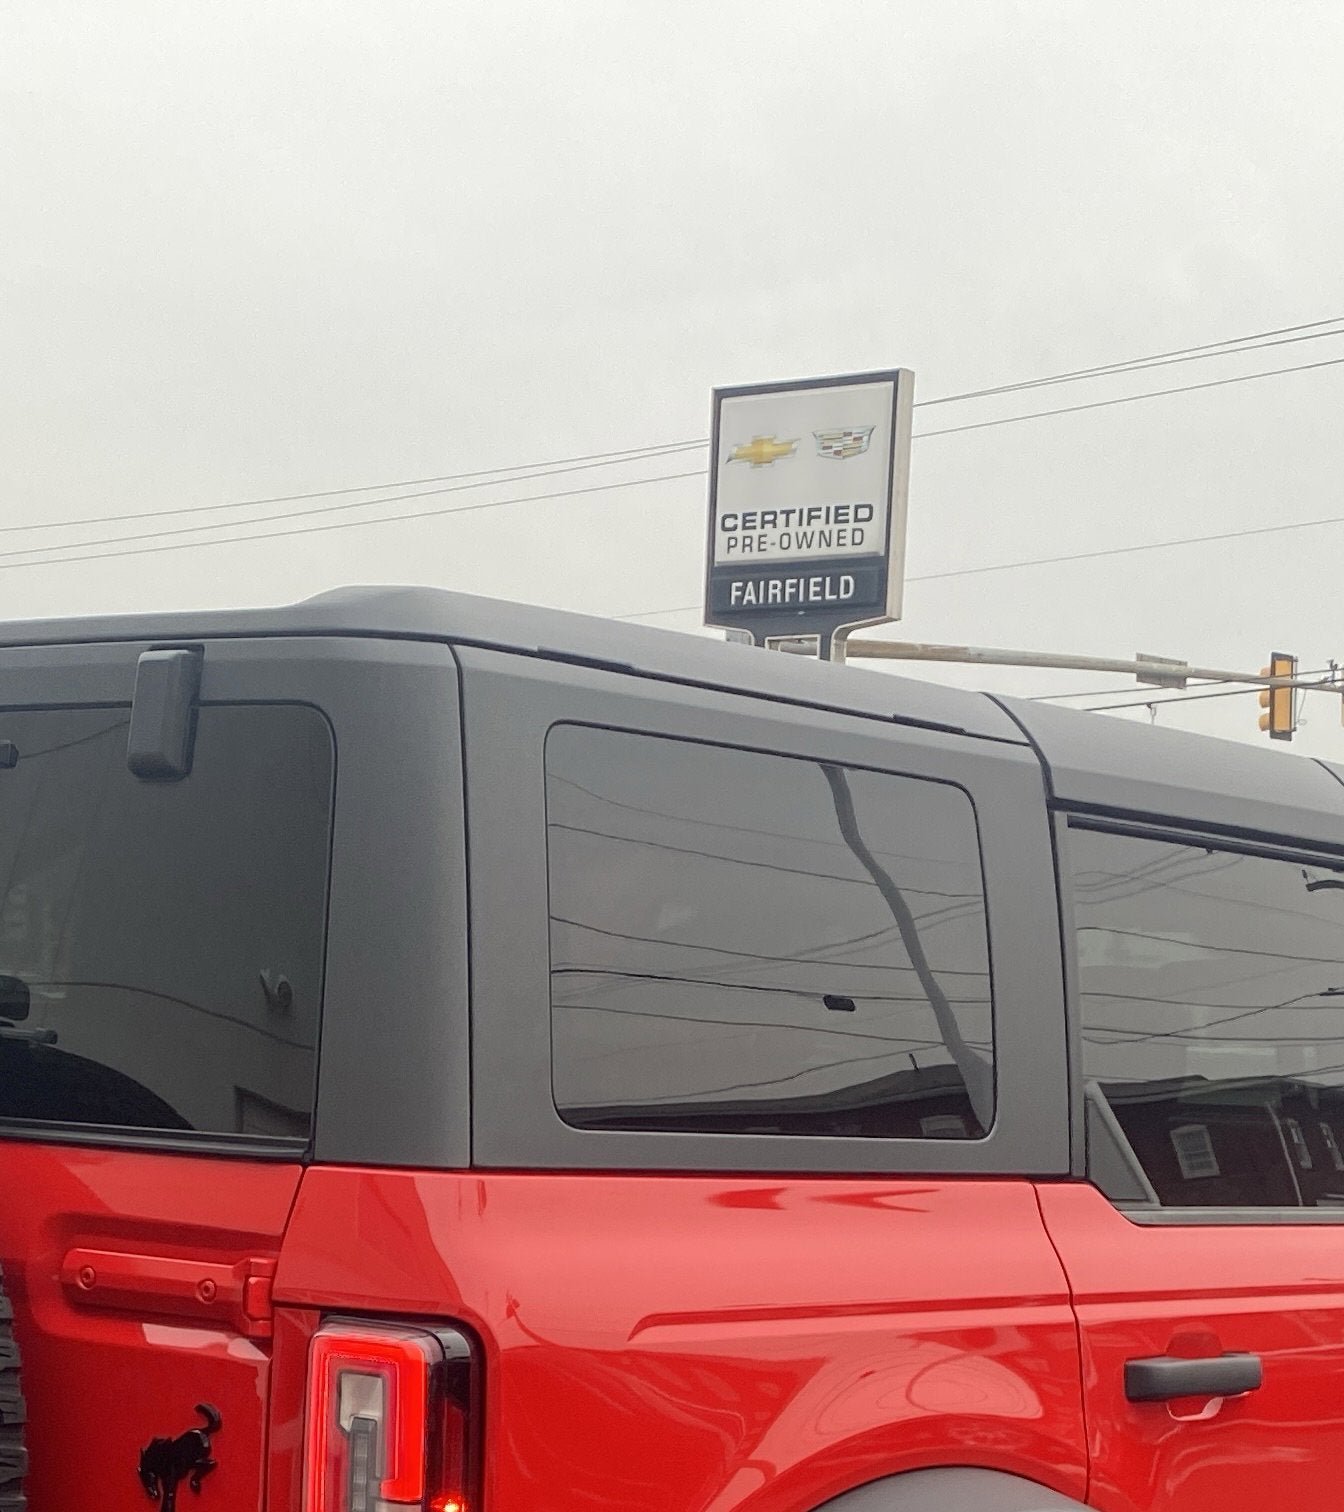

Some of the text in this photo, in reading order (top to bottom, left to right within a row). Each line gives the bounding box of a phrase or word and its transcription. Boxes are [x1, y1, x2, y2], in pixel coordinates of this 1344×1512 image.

[720, 503, 874, 533] CERTIFIED
[726, 527, 865, 554] PRE-OWNED
[730, 575, 855, 606] FAIRFIELD
